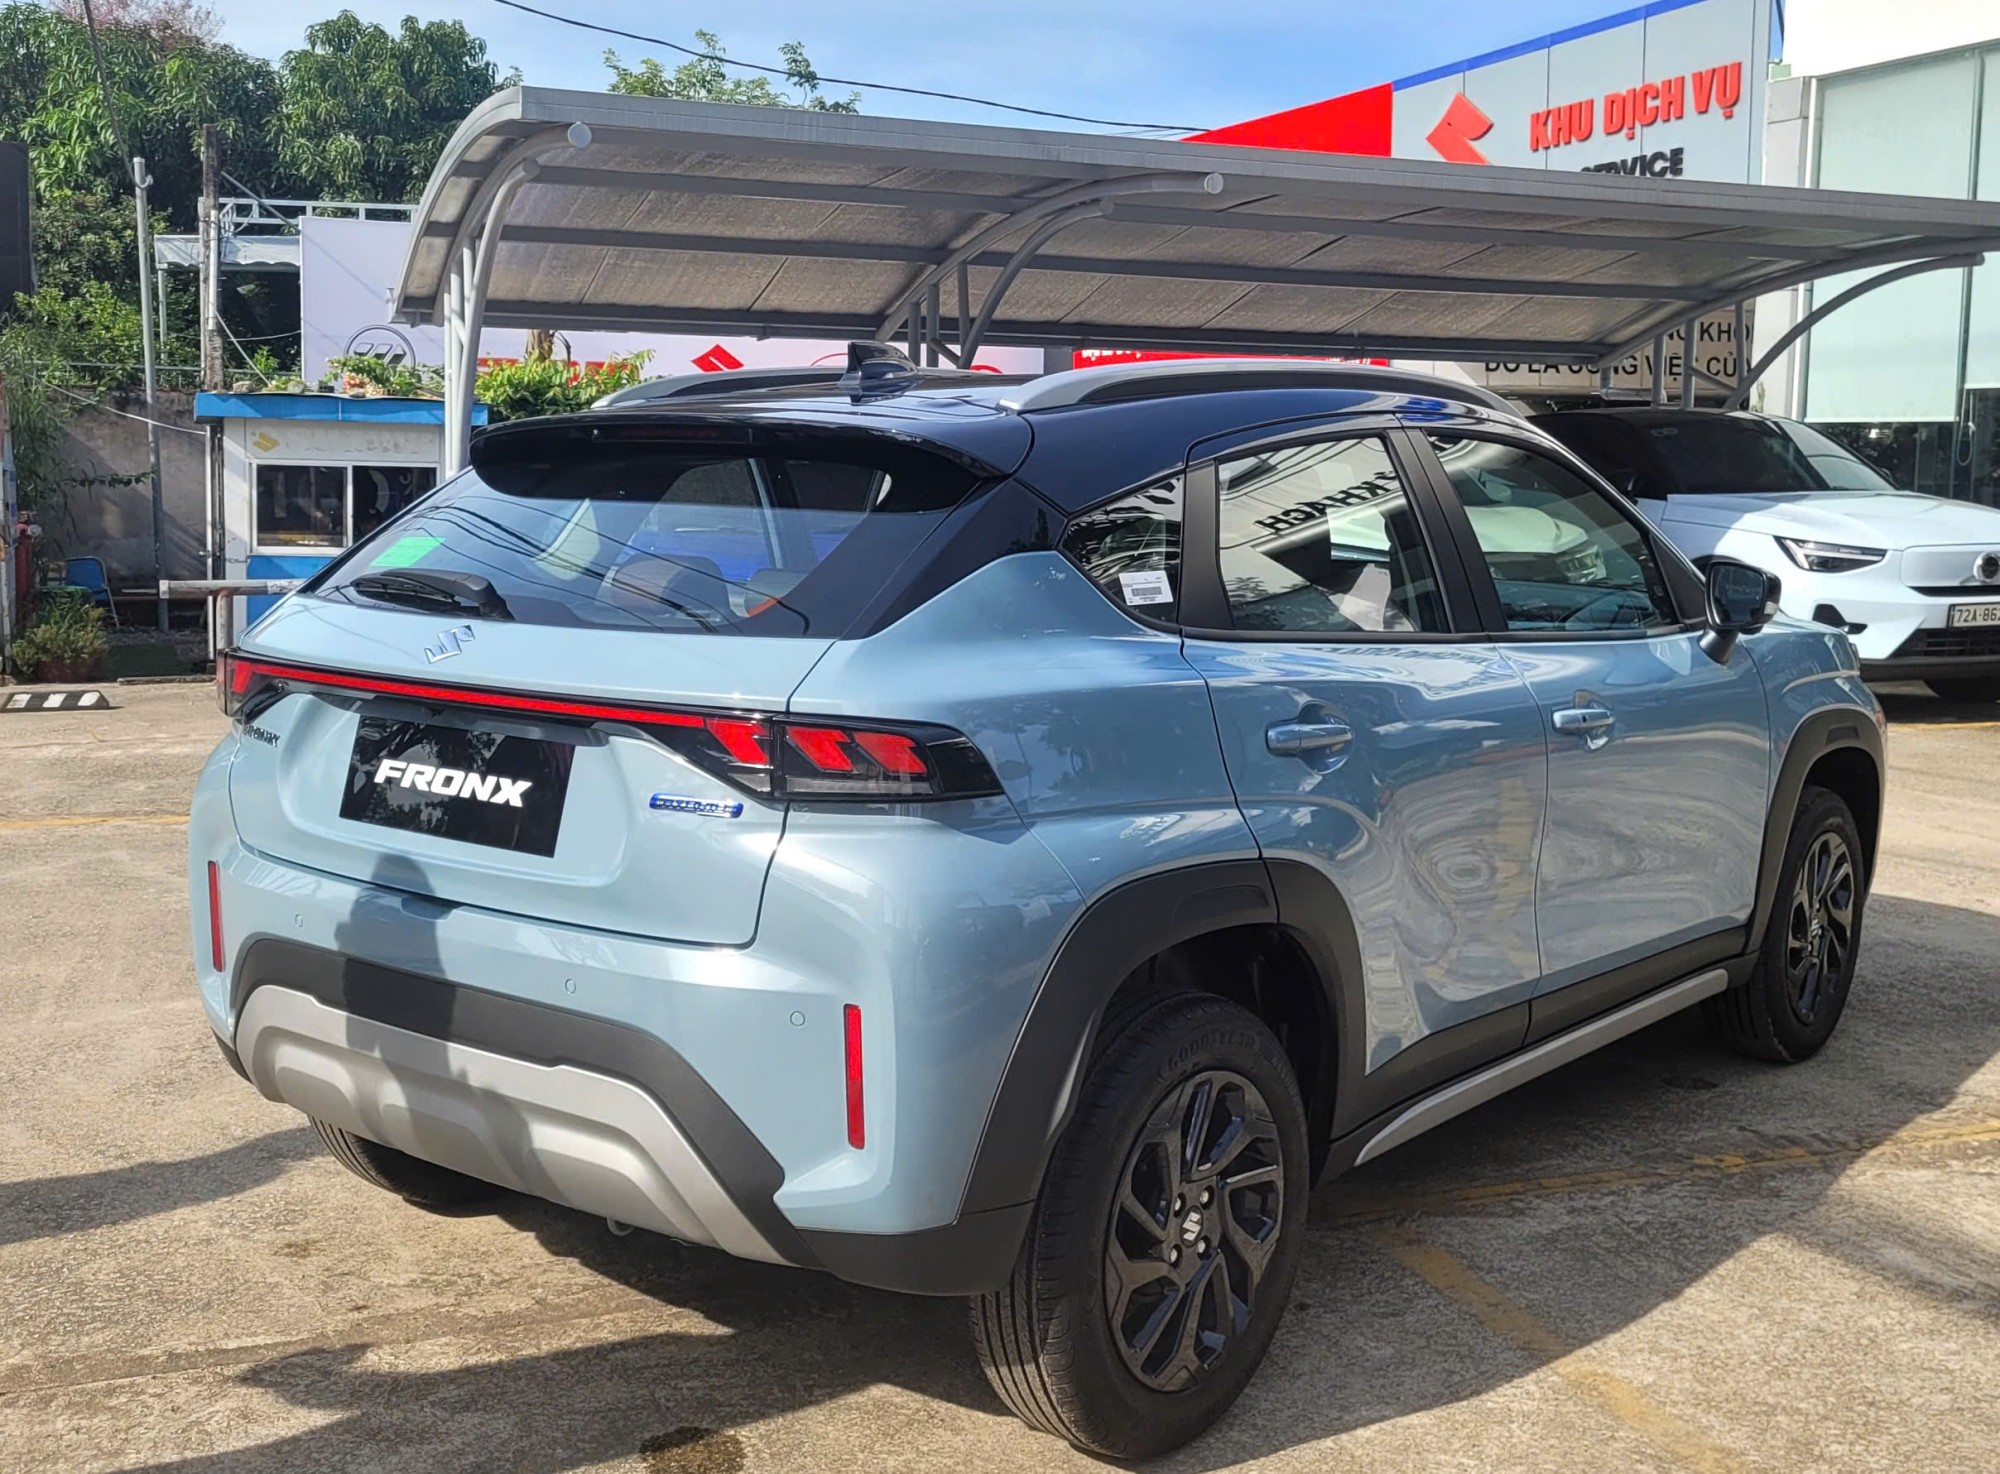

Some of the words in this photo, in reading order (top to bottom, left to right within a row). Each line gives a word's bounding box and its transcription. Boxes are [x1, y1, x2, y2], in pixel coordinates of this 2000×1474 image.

[1530, 99, 1594, 153] KHU
[1603, 75, 1685, 140] DỊCH
[1691, 61, 1742, 120] VỤ
[374, 758, 533, 808] FRONX
